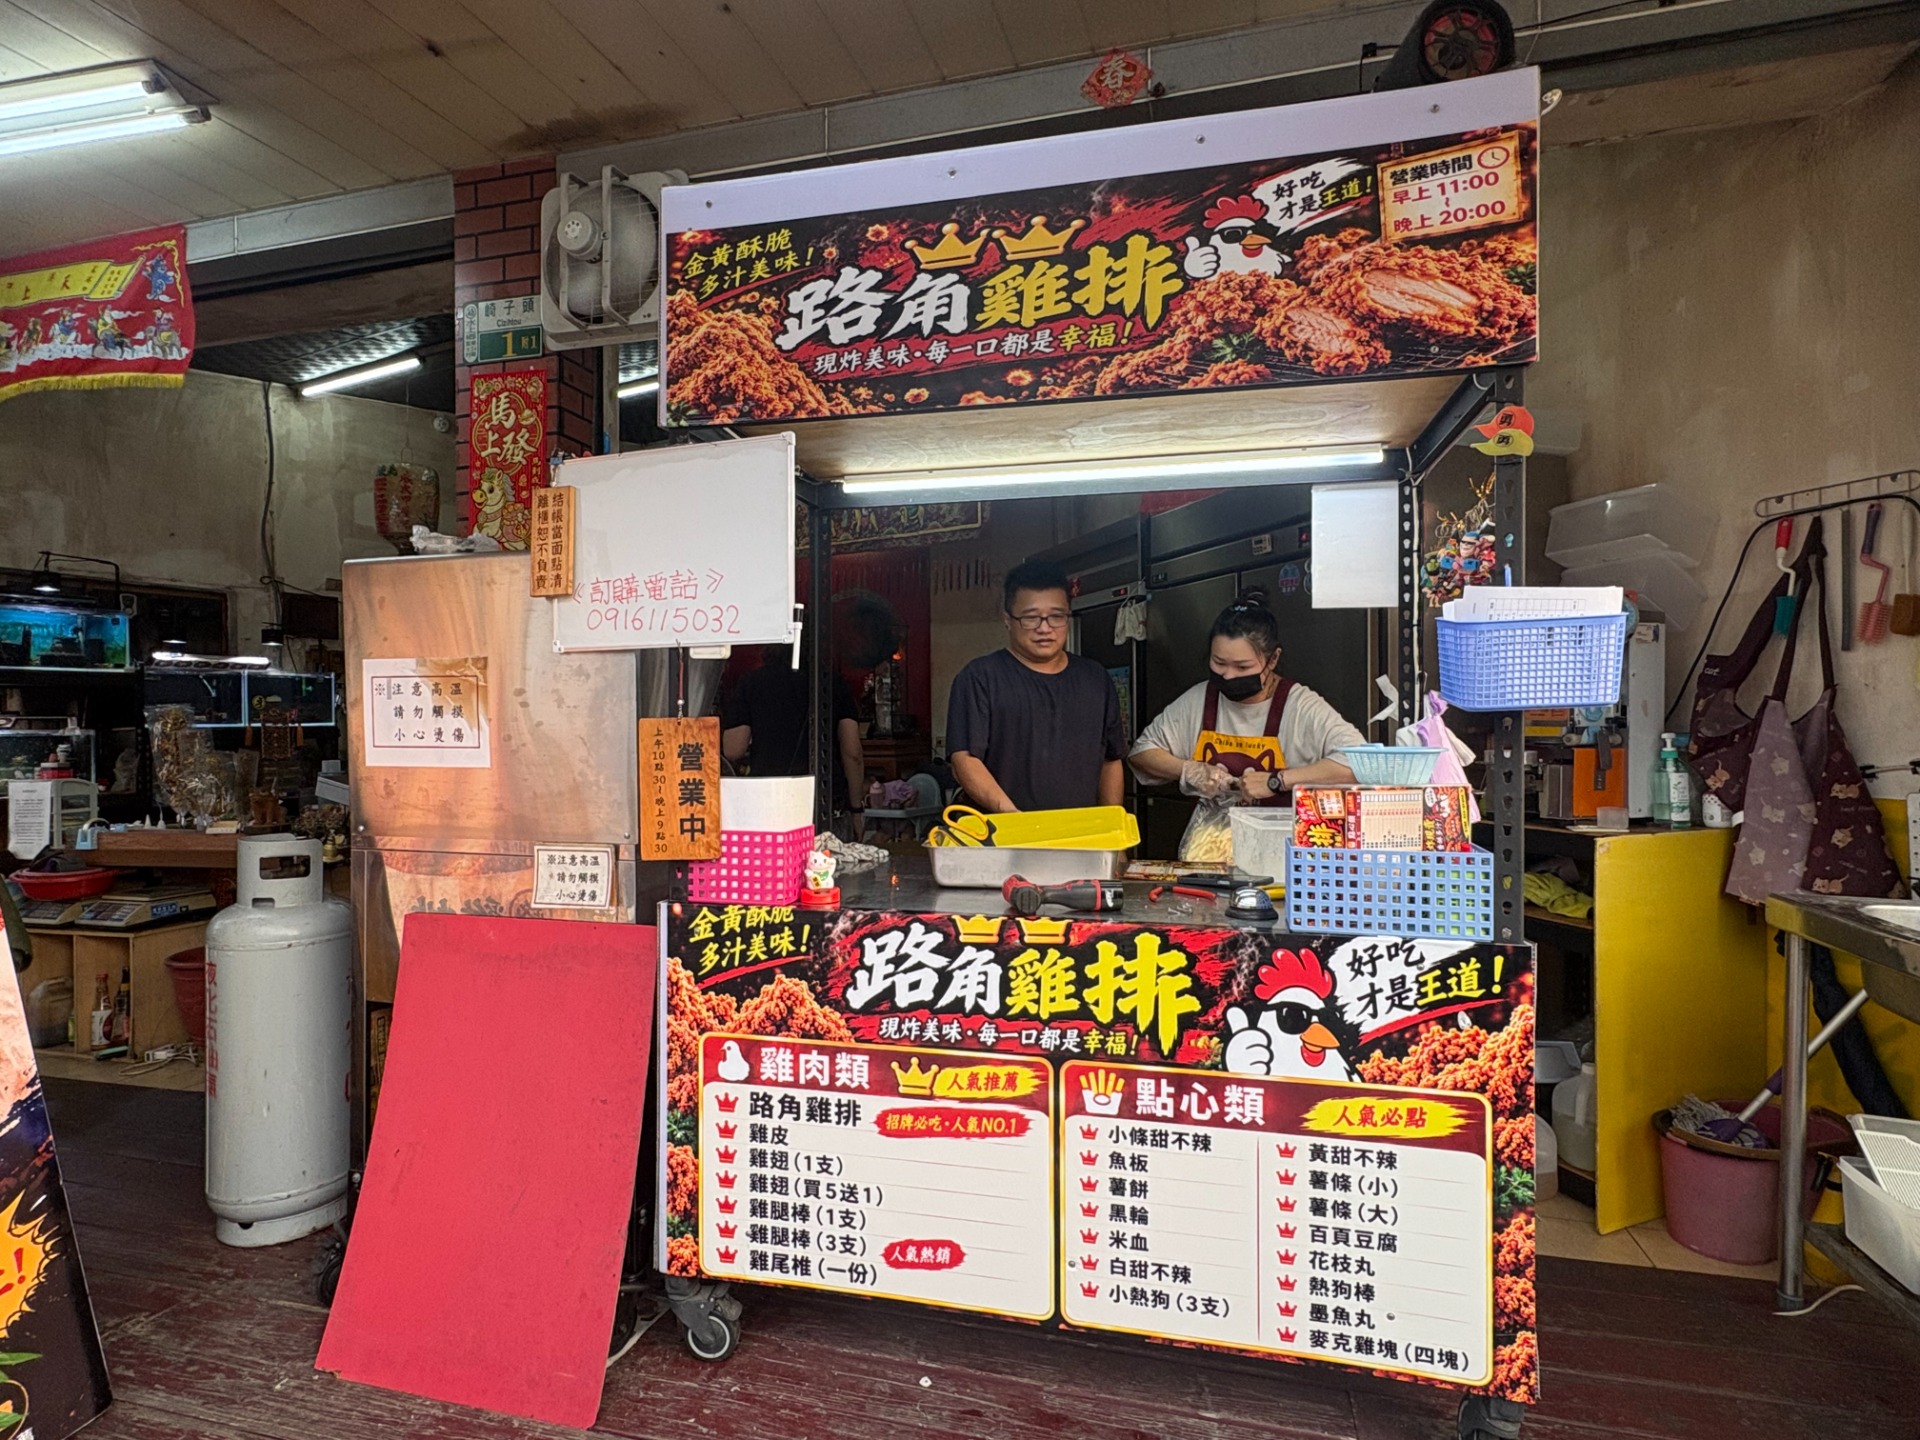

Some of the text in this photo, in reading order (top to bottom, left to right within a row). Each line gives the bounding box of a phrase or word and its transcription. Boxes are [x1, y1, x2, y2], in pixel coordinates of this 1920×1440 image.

[1099, 53, 1134, 88] 春
[1389, 154, 1473, 186] 營業時間
[1272, 171, 1327, 202] 好吃
[1279, 175, 1373, 220] 才是王道!
[1392, 171, 1500, 205] 早上 11:00
[1393, 200, 1506, 233] 晚上 20:00
[682, 227, 792, 279] 金黃酥脆
[698, 246, 814, 298] 多汁美味!
[485, 297, 534, 317] 崎子頭
[775, 235, 1184, 351] 路角雞排
[501, 332, 517, 357] 1
[536, 494, 549, 590] 離櫃恕不負責
[550, 493, 564, 589] 結帳當面點清
[587, 604, 740, 634] 0916115032
[394, 727, 464, 743] 小心燙傷
[677, 742, 707, 842] 營業中
[688, 905, 796, 943] 金黃酥脆
[698, 924, 811, 976] 多汁美味!
[1345, 940, 1425, 982] 好吃
[846, 921, 1201, 1055] 路角雞排
[1356, 955, 1505, 1021] 才是王道!
[760, 1046, 870, 1090] 雞肉類
[946, 1068, 1019, 1093] 人氣推薦
[749, 1091, 862, 1128] 路角雞排
[1136, 1077, 1265, 1126] 點心類
[1333, 1105, 1428, 1129] 人氣必點
[749, 1122, 789, 1147] 雞皮
[1108, 1125, 1212, 1153] 小條甜不辣
[749, 1148, 844, 1177] 雞翅(1支)
[1108, 1151, 1149, 1173] 魚板
[1309, 1143, 1398, 1170] 黃甜不辣
[1108, 1177, 1149, 1199] 薯餅
[1309, 1170, 1398, 1199] 薯條(小)
[749, 1198, 867, 1231] 雞腿棒(1支)
[1108, 1204, 1149, 1226] 黑輪
[1309, 1197, 1398, 1226] 薯條(大)
[749, 1223, 867, 1257] 雞腿棒(3支)
[1108, 1230, 1149, 1252] 米血
[1309, 1224, 1398, 1253] 百頁豆腐
[889, 1245, 952, 1266] 人氣熱銷
[1109, 1256, 1192, 1285] 白甜不辣
[1309, 1250, 1375, 1277] 花枝丸
[1109, 1284, 1230, 1318] 小熱狗(3支)
[1309, 1276, 1375, 1303] 熱狗棒
[1309, 1303, 1376, 1330] 墨魚丸
[1309, 1329, 1470, 1372] 麥克雞塊(四塊)
